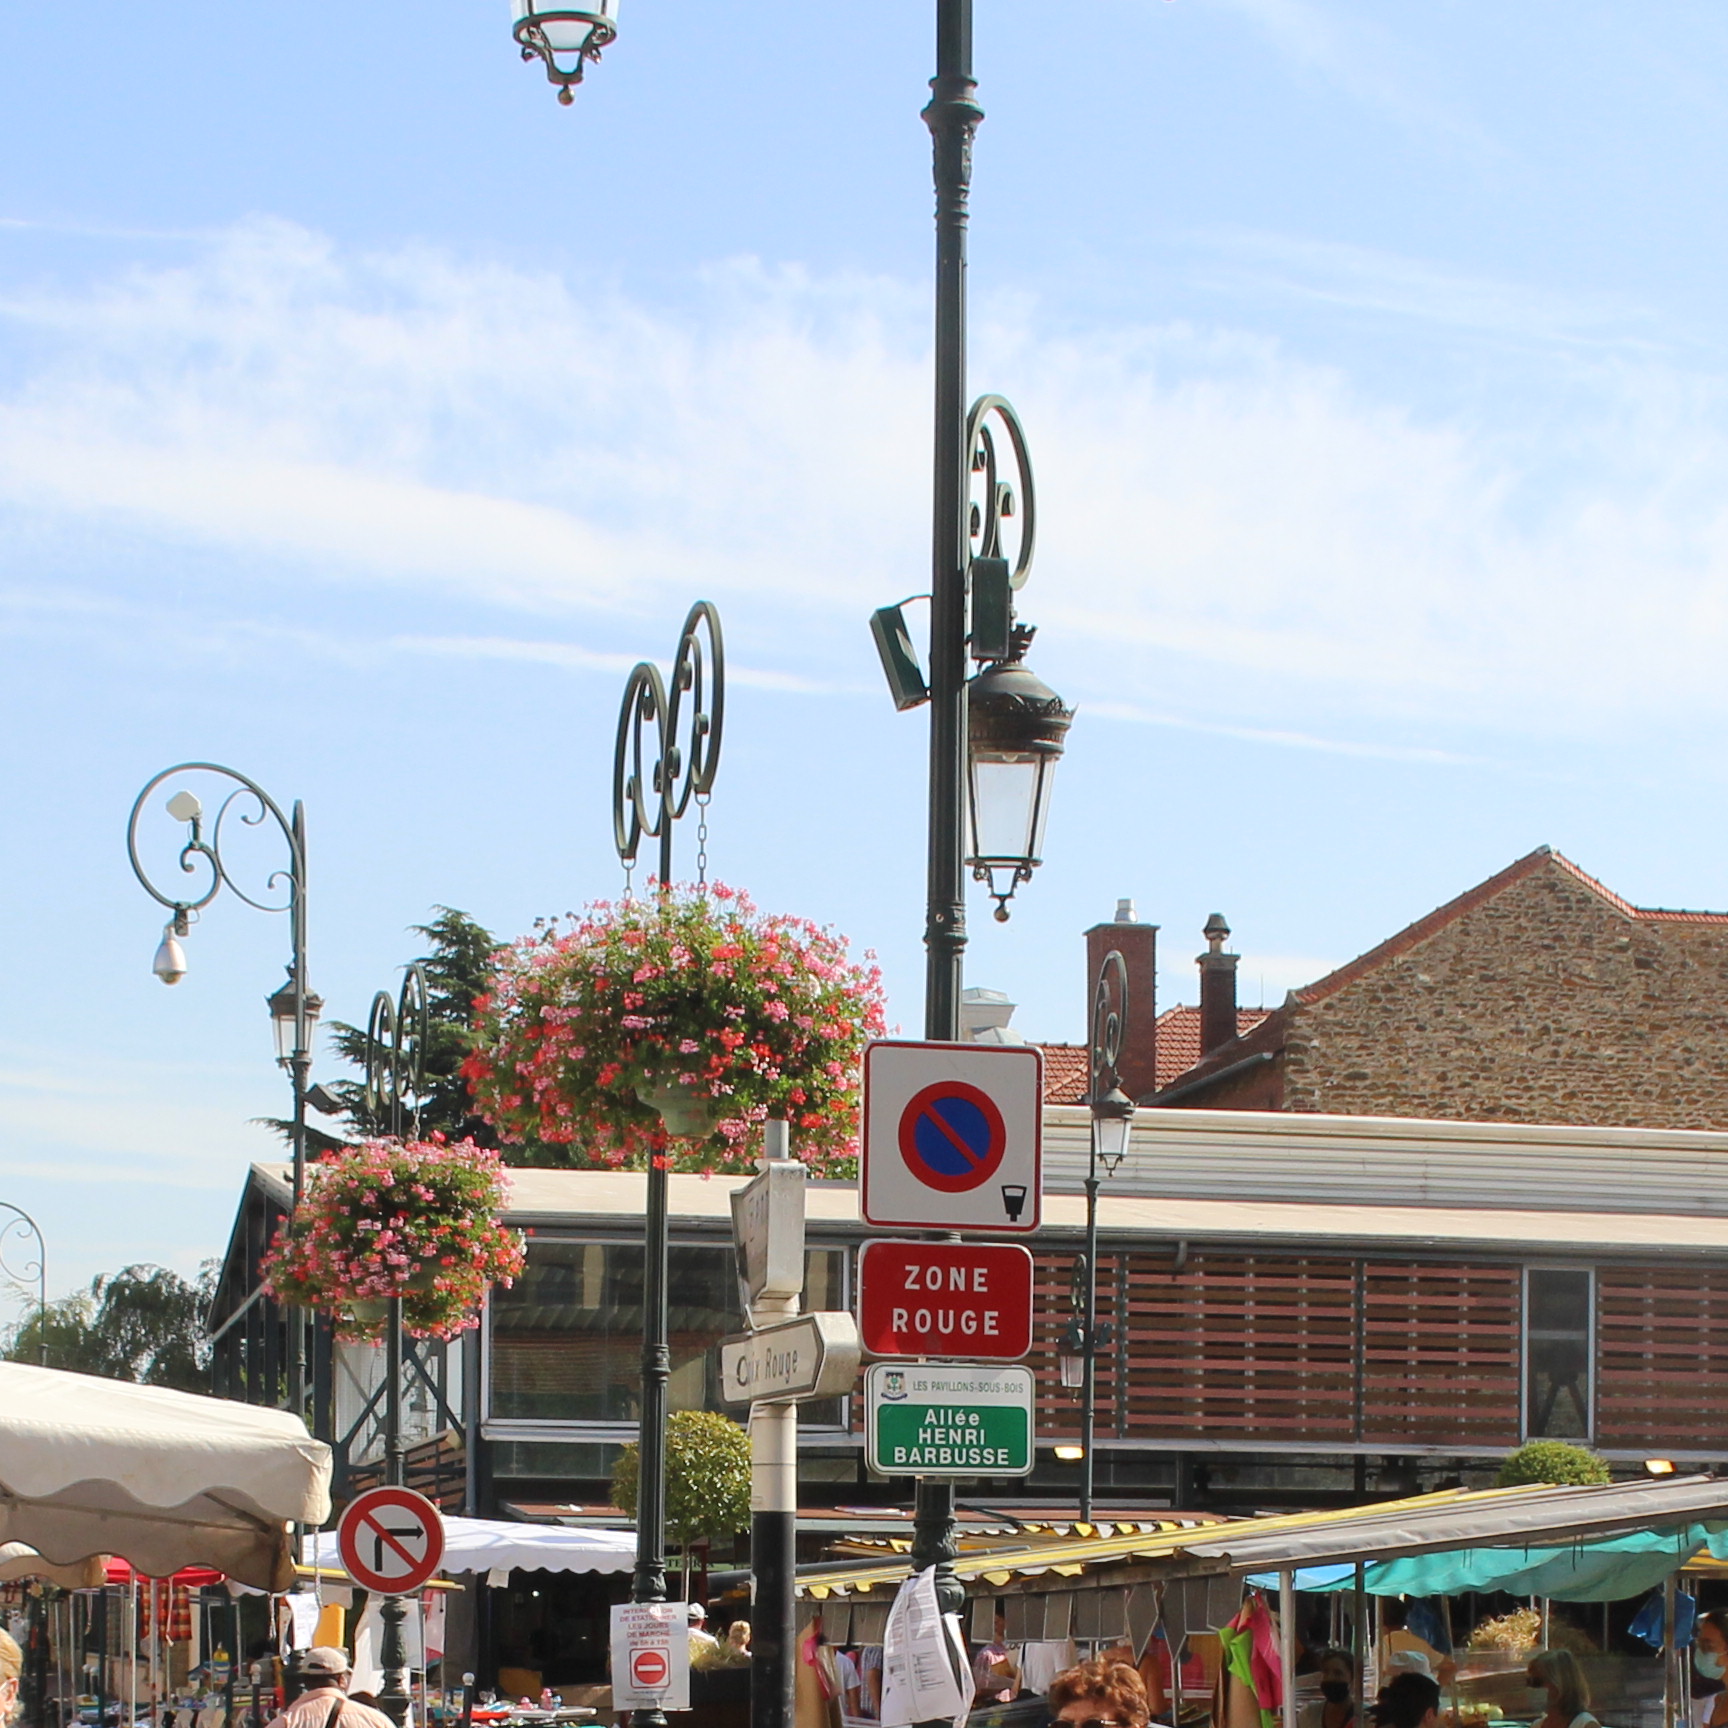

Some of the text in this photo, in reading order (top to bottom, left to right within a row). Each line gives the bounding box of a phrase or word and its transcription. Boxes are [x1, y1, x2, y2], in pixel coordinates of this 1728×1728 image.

[904, 1265, 988, 1292] ZONE
[892, 1308, 999, 1335] ROUGE
[765, 1347, 798, 1385] Rouge
[913, 1381, 1023, 1393] LES PAVILLONS-SOUS-BOIS
[924, 1408, 980, 1426] Allée
[918, 1428, 985, 1445] HENRI
[894, 1447, 1009, 1465] BARBUSSE
